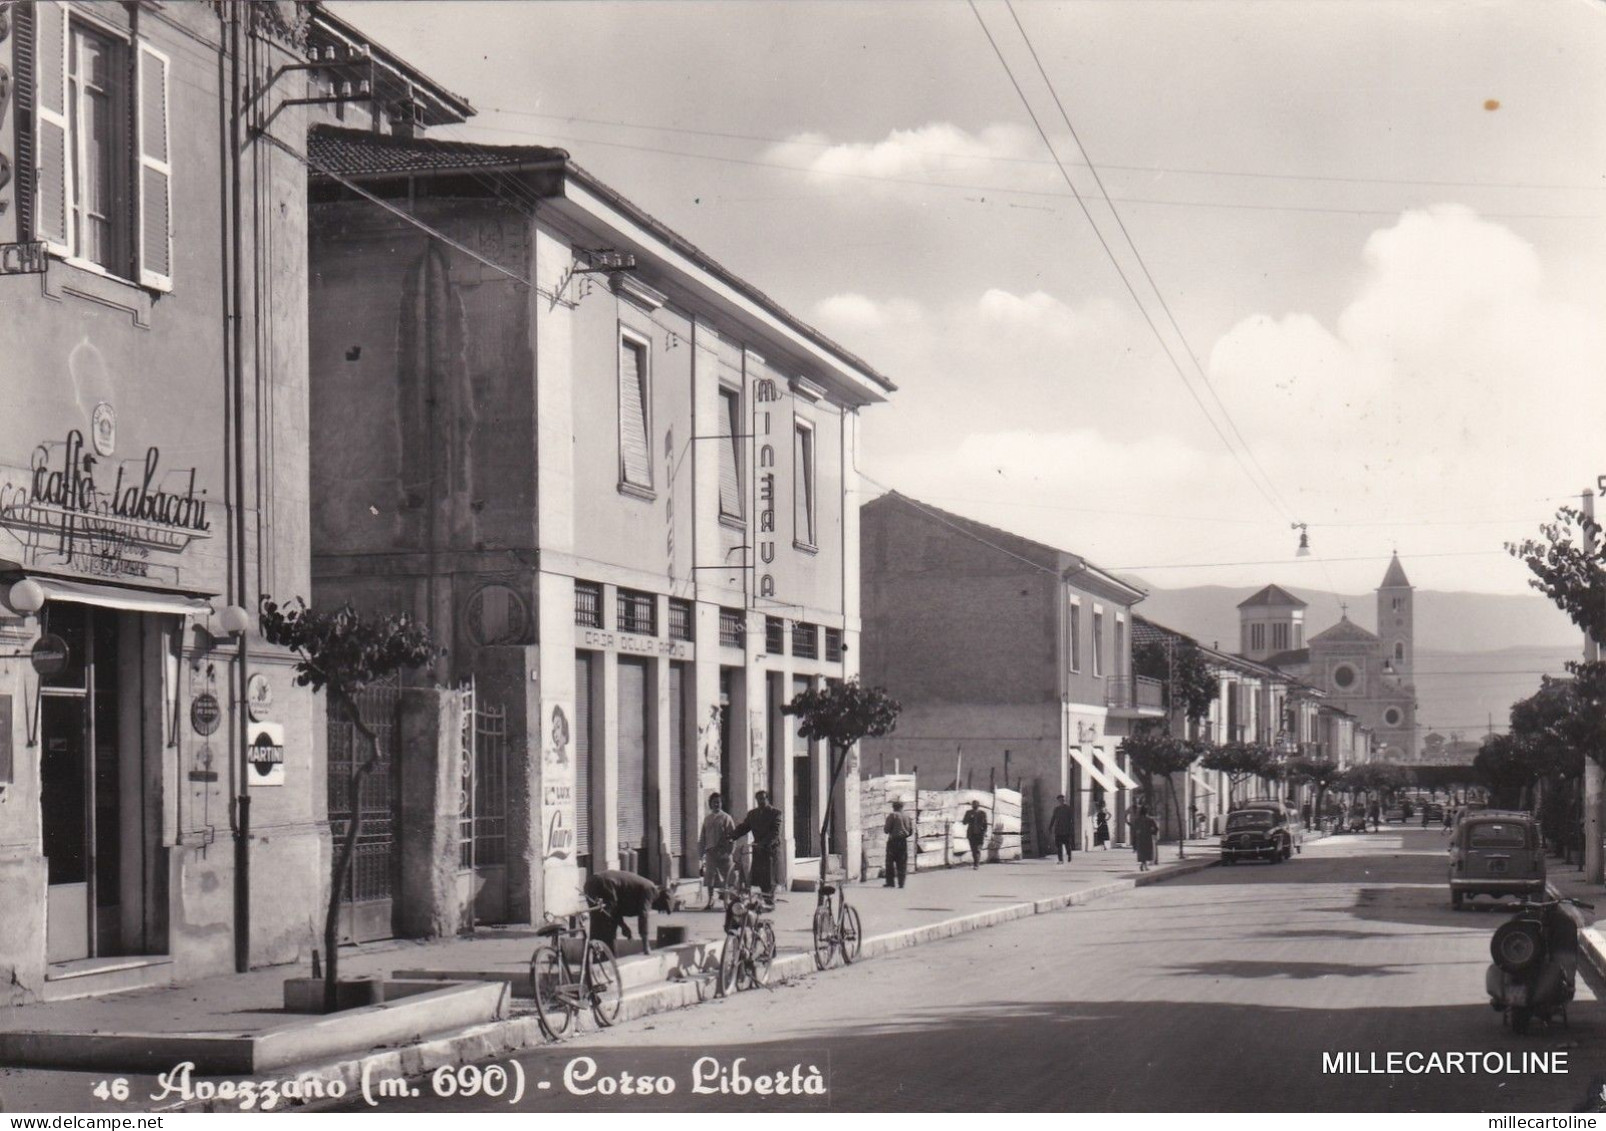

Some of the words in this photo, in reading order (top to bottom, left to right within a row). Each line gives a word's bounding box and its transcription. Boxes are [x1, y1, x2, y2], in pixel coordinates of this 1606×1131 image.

[0, 244, 43, 272] CHI
[111, 446, 210, 531] tabacchi
[757, 378, 777, 598] MINERVA
[585, 630, 614, 647] CASA
[621, 635, 653, 653] DELLA
[659, 640, 685, 658] RADIO
[248, 746, 283, 763] MARTINI
